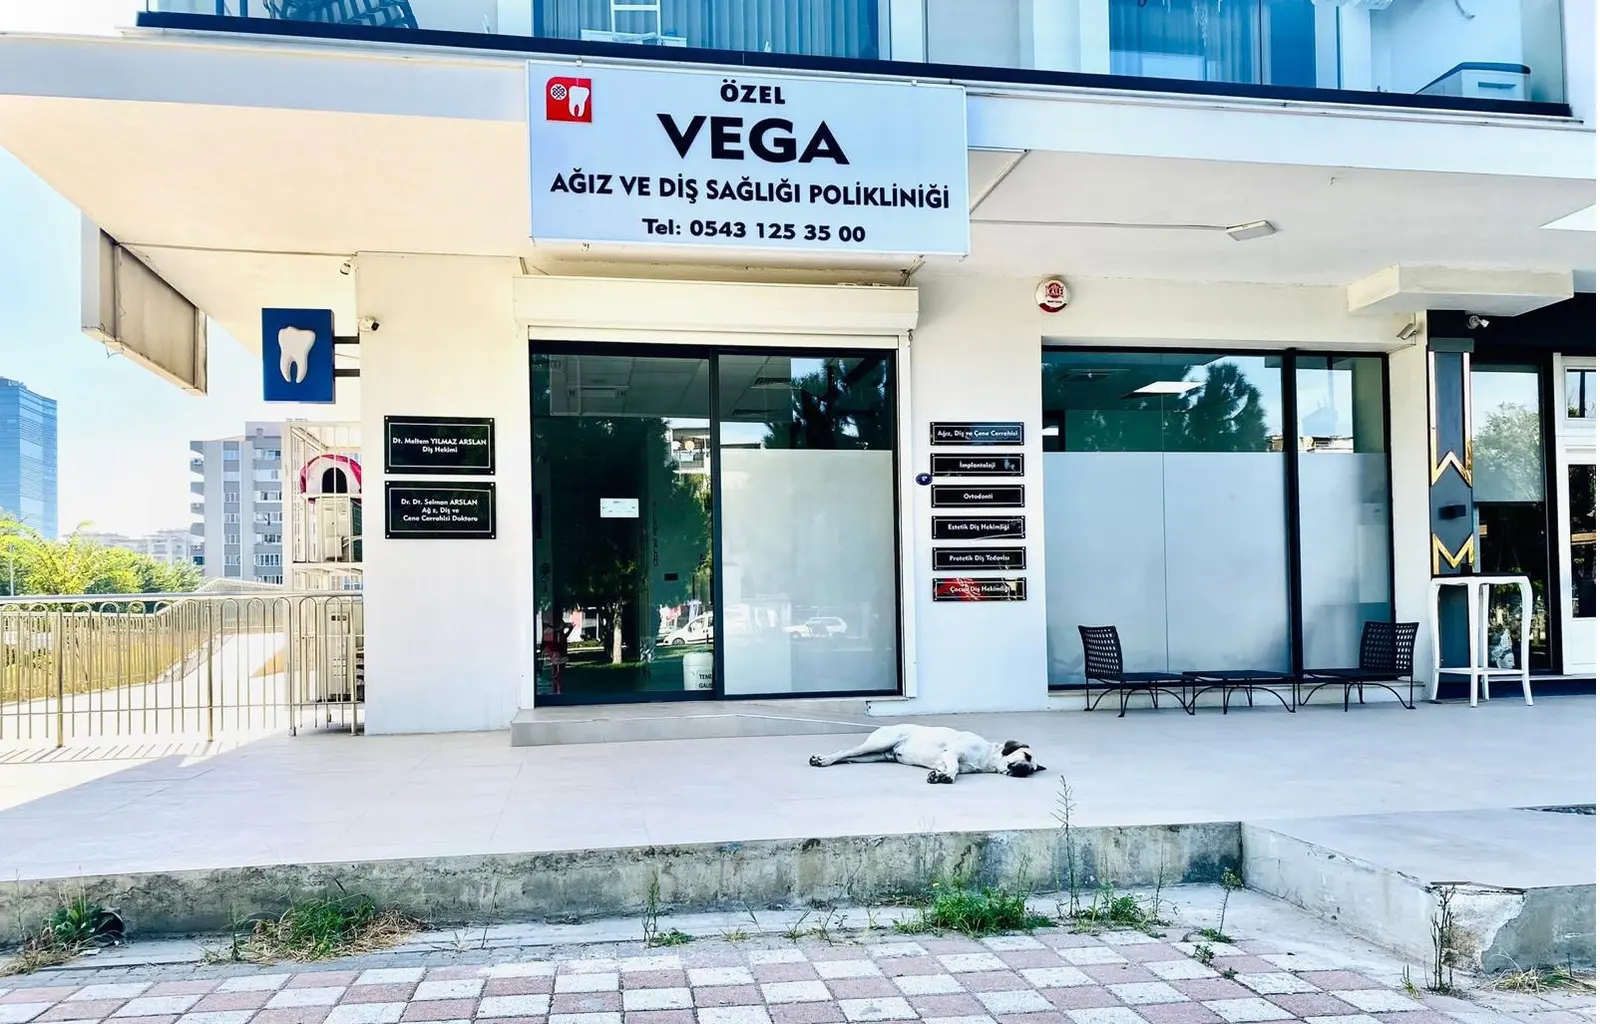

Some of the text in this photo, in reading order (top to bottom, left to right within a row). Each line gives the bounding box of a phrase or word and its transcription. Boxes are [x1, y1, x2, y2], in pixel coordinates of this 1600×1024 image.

[721, 79, 786, 104] ÖZEL
[657, 114, 850, 164] VEGA
[551, 168, 949, 209] AĞIZ VE DİŞ SAĞLIĞI POLİKLİNİĞİ
[642, 219, 866, 242] Tel: 0543 125 35 00
[392, 437, 403, 445] Dt.
[430, 438, 457, 446] YILMAZ
[458, 438, 487, 446] ARSLAN
[422, 446, 433, 454] Diş
[412, 498, 423, 506] Dt.
[424, 498, 448, 506] Selman
